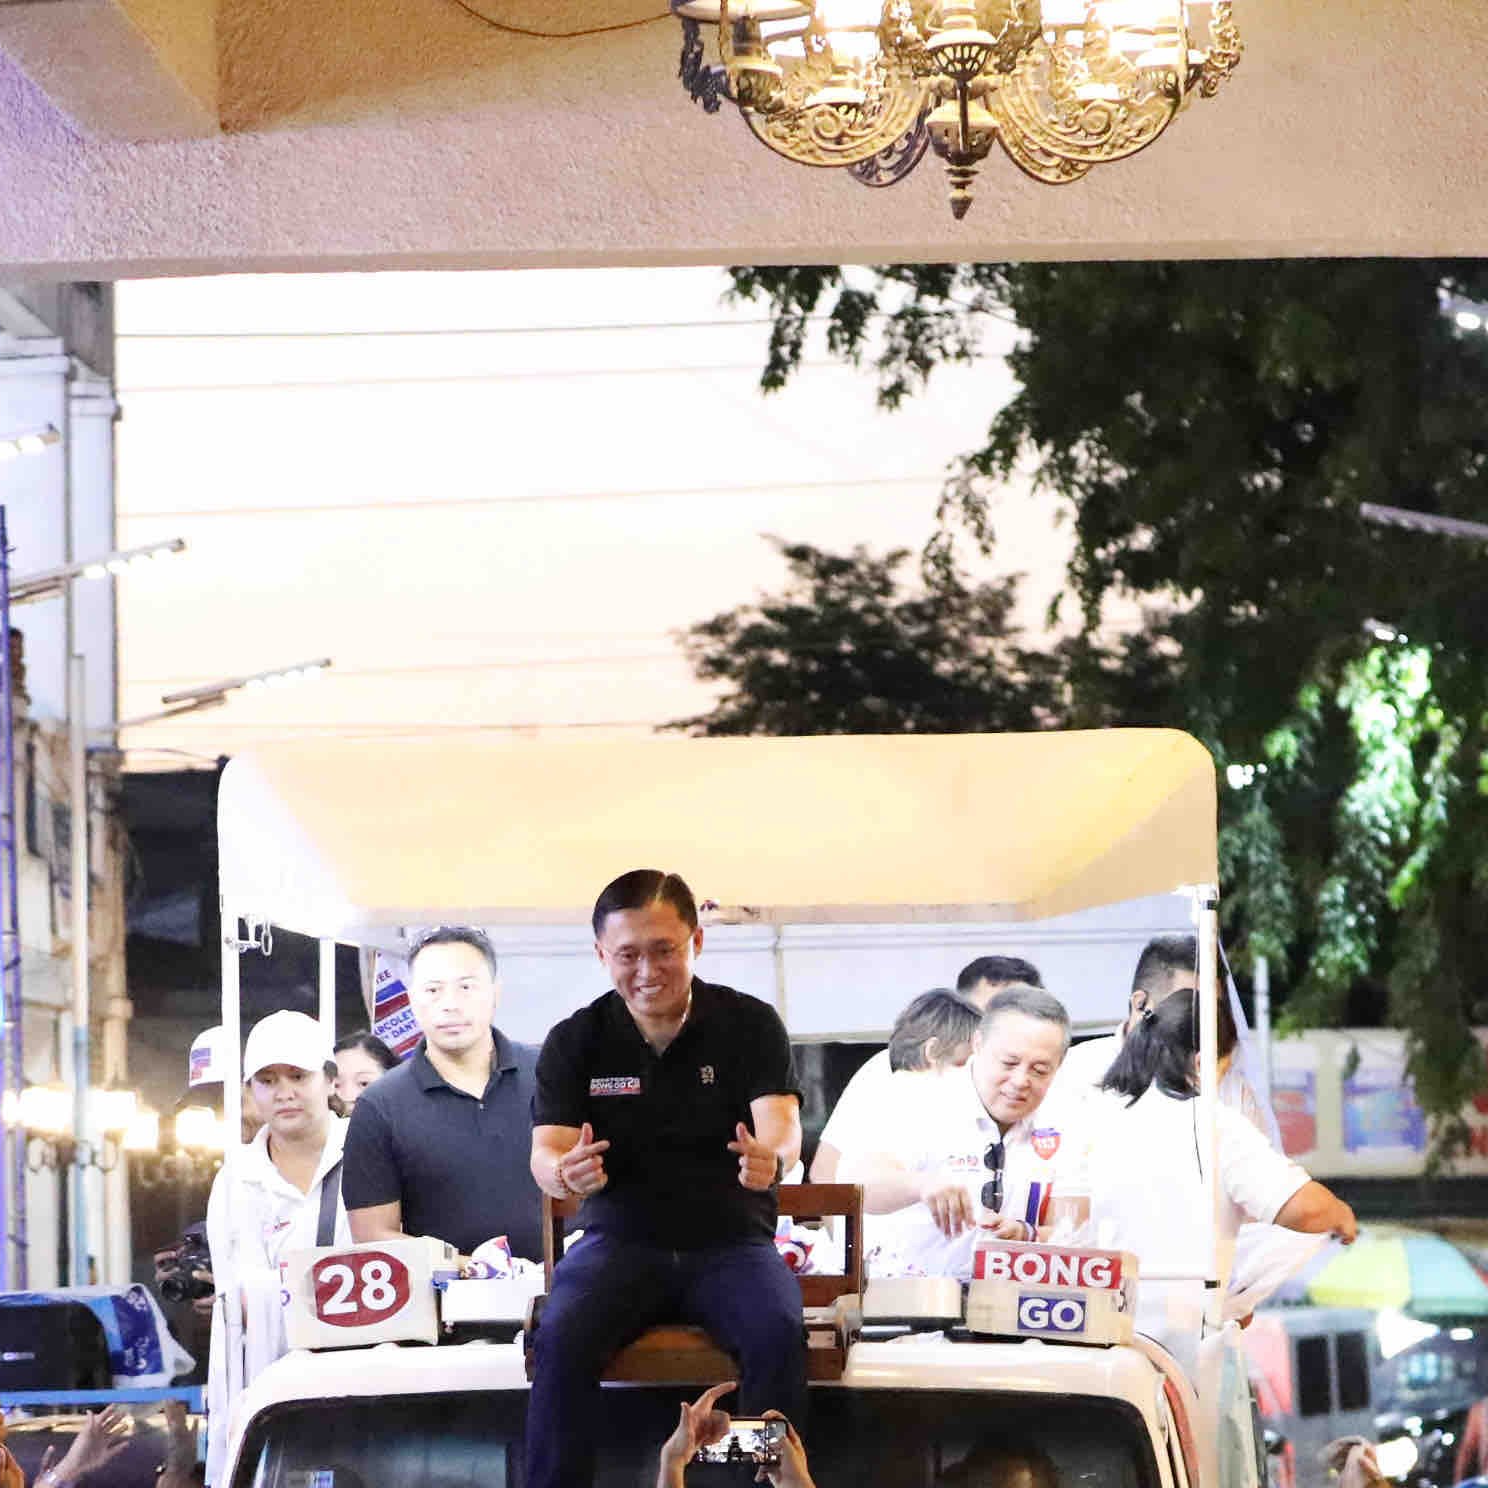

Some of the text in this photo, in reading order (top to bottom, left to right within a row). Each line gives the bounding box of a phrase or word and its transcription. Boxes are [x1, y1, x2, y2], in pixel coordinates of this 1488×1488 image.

[318, 1260, 397, 1316] 28
[983, 1250, 1112, 1290] BONG
[1018, 1298, 1085, 1330] GO
